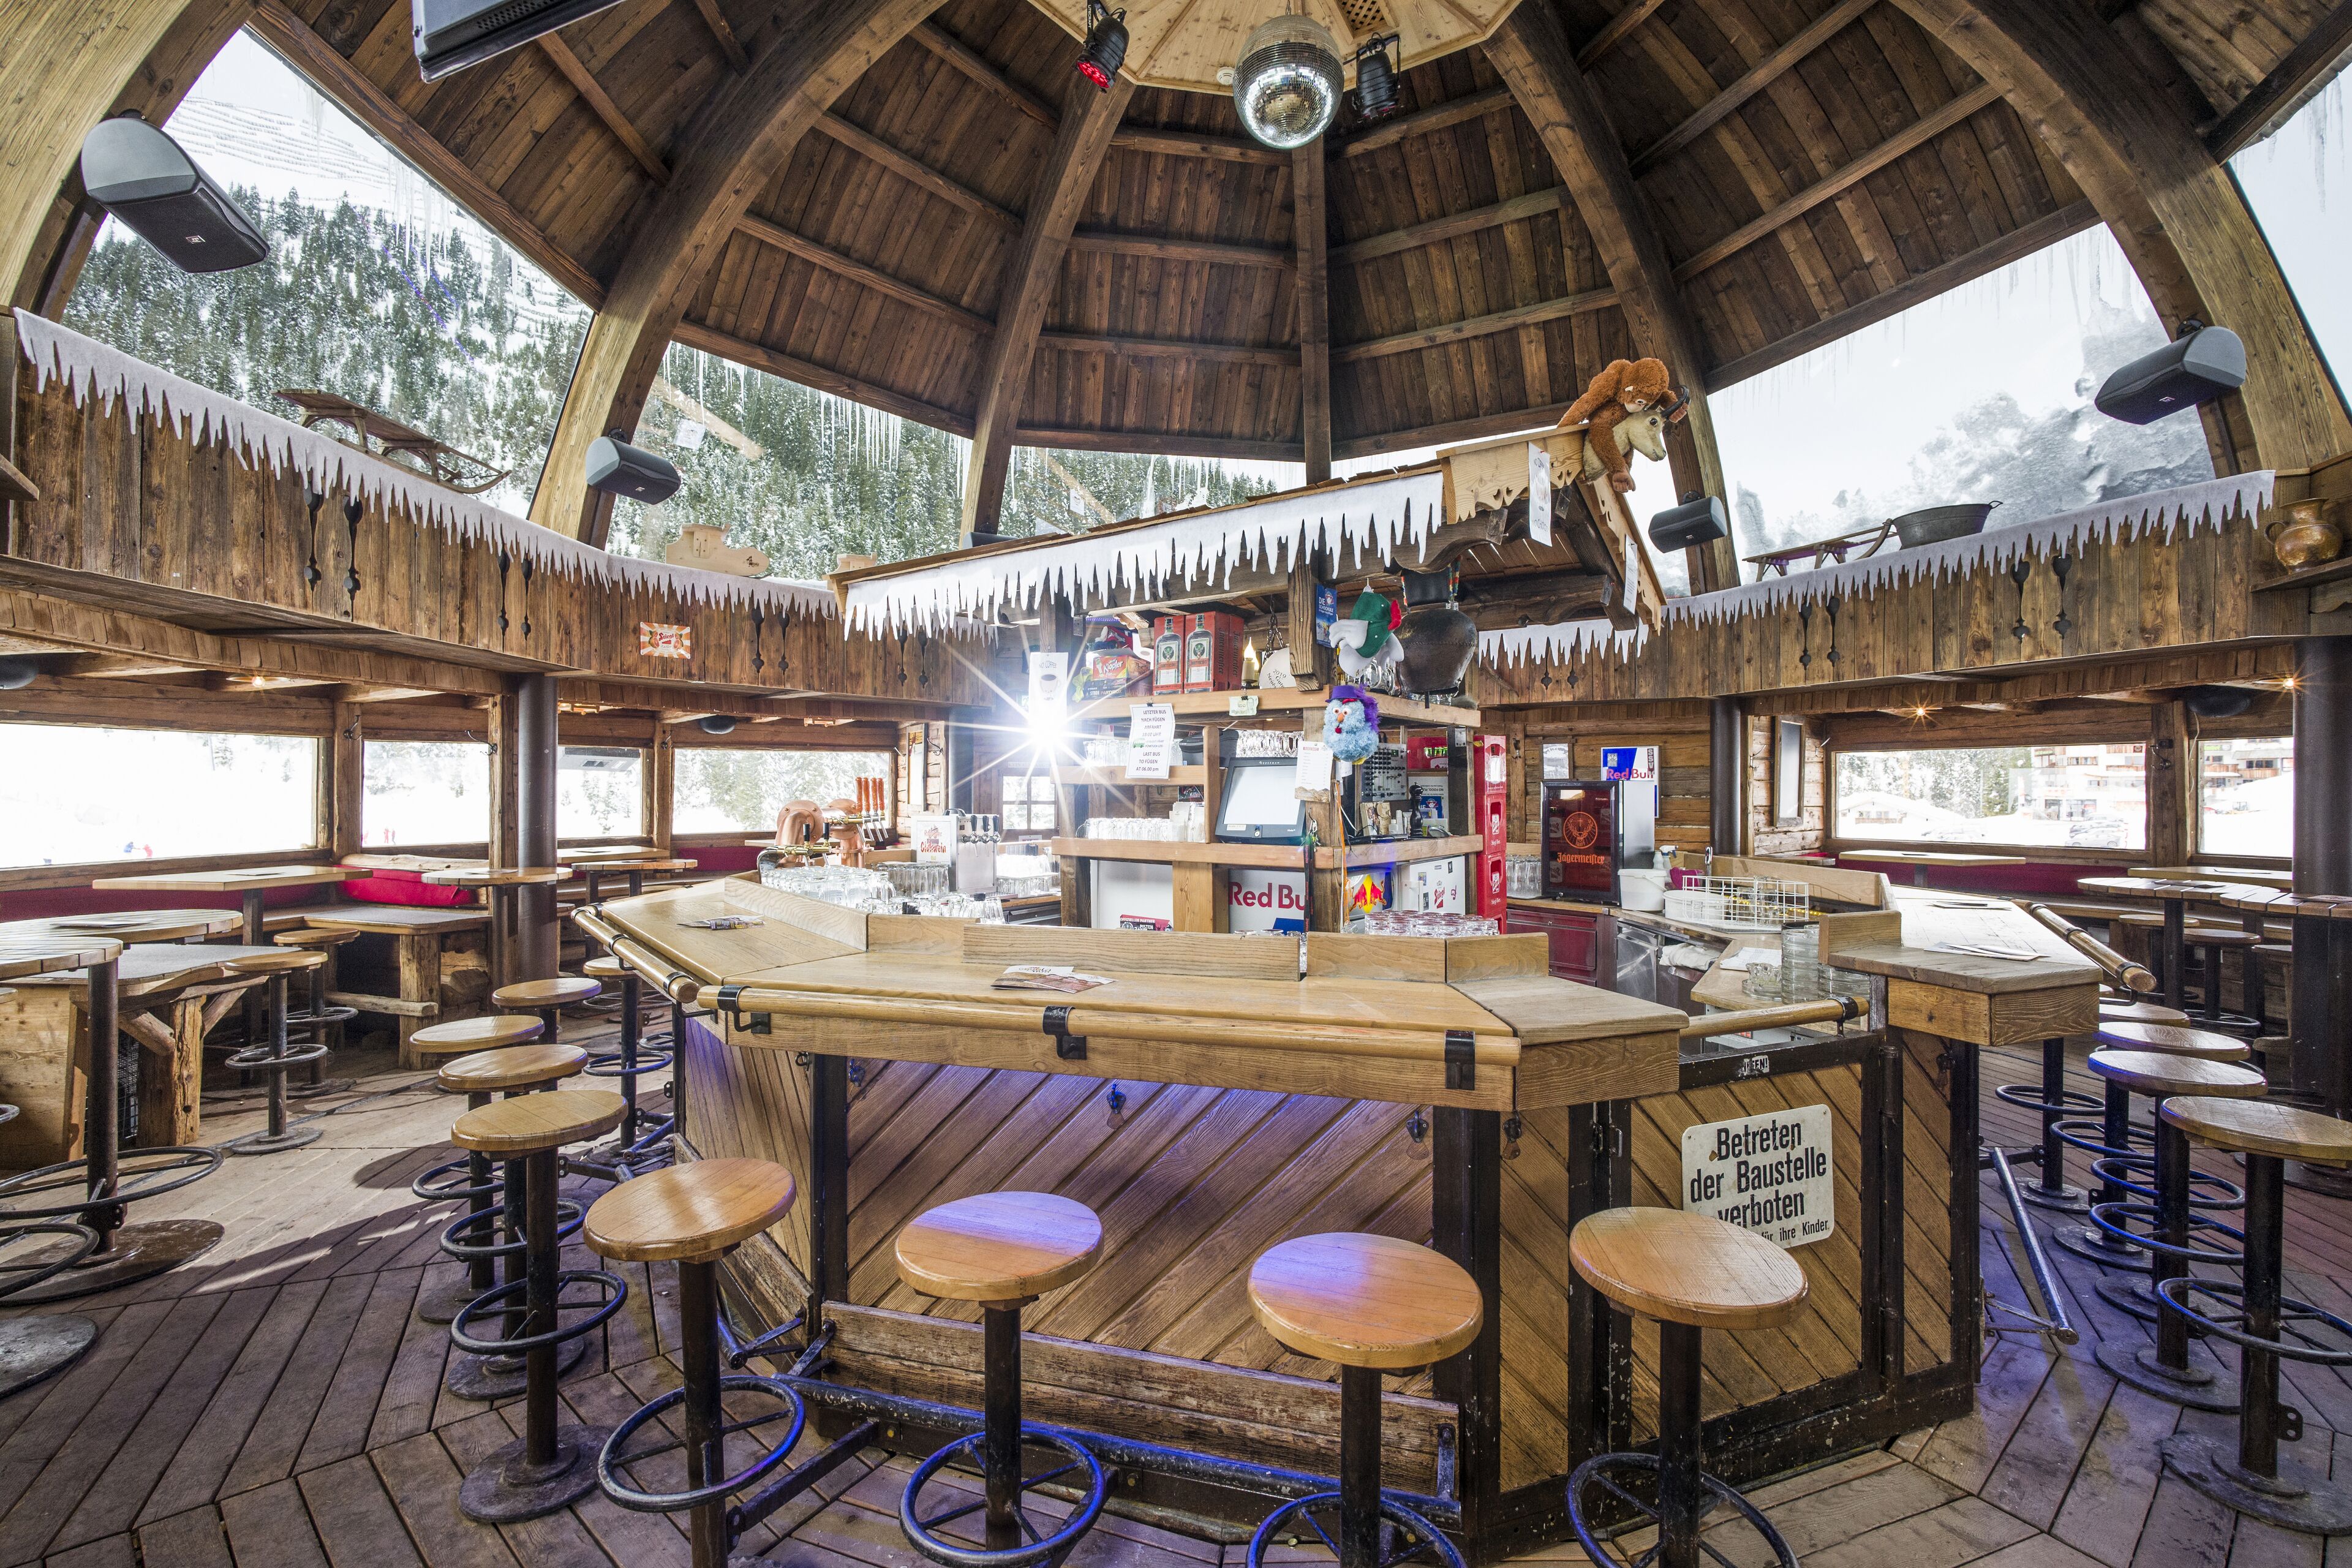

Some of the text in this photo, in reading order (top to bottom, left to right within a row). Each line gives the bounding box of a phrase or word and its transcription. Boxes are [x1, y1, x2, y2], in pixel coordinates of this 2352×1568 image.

[658, 632, 674, 641] Stiegl
[1103, 659, 1123, 673] Klopfer
[1273, 669, 1286, 679] 2019
[1607, 768, 1629, 780] Red
[1557, 852, 1605, 864] Jägermeister
[1229, 881, 1273, 908] Red
[1278, 884, 1305, 911] Bu
[1717, 1119, 1801, 1161] Betreten
[1690, 1146, 1826, 1203] der Baustelle
[1717, 1189, 1805, 1229] verboten
[1779, 1227, 1796, 1242] ihre
